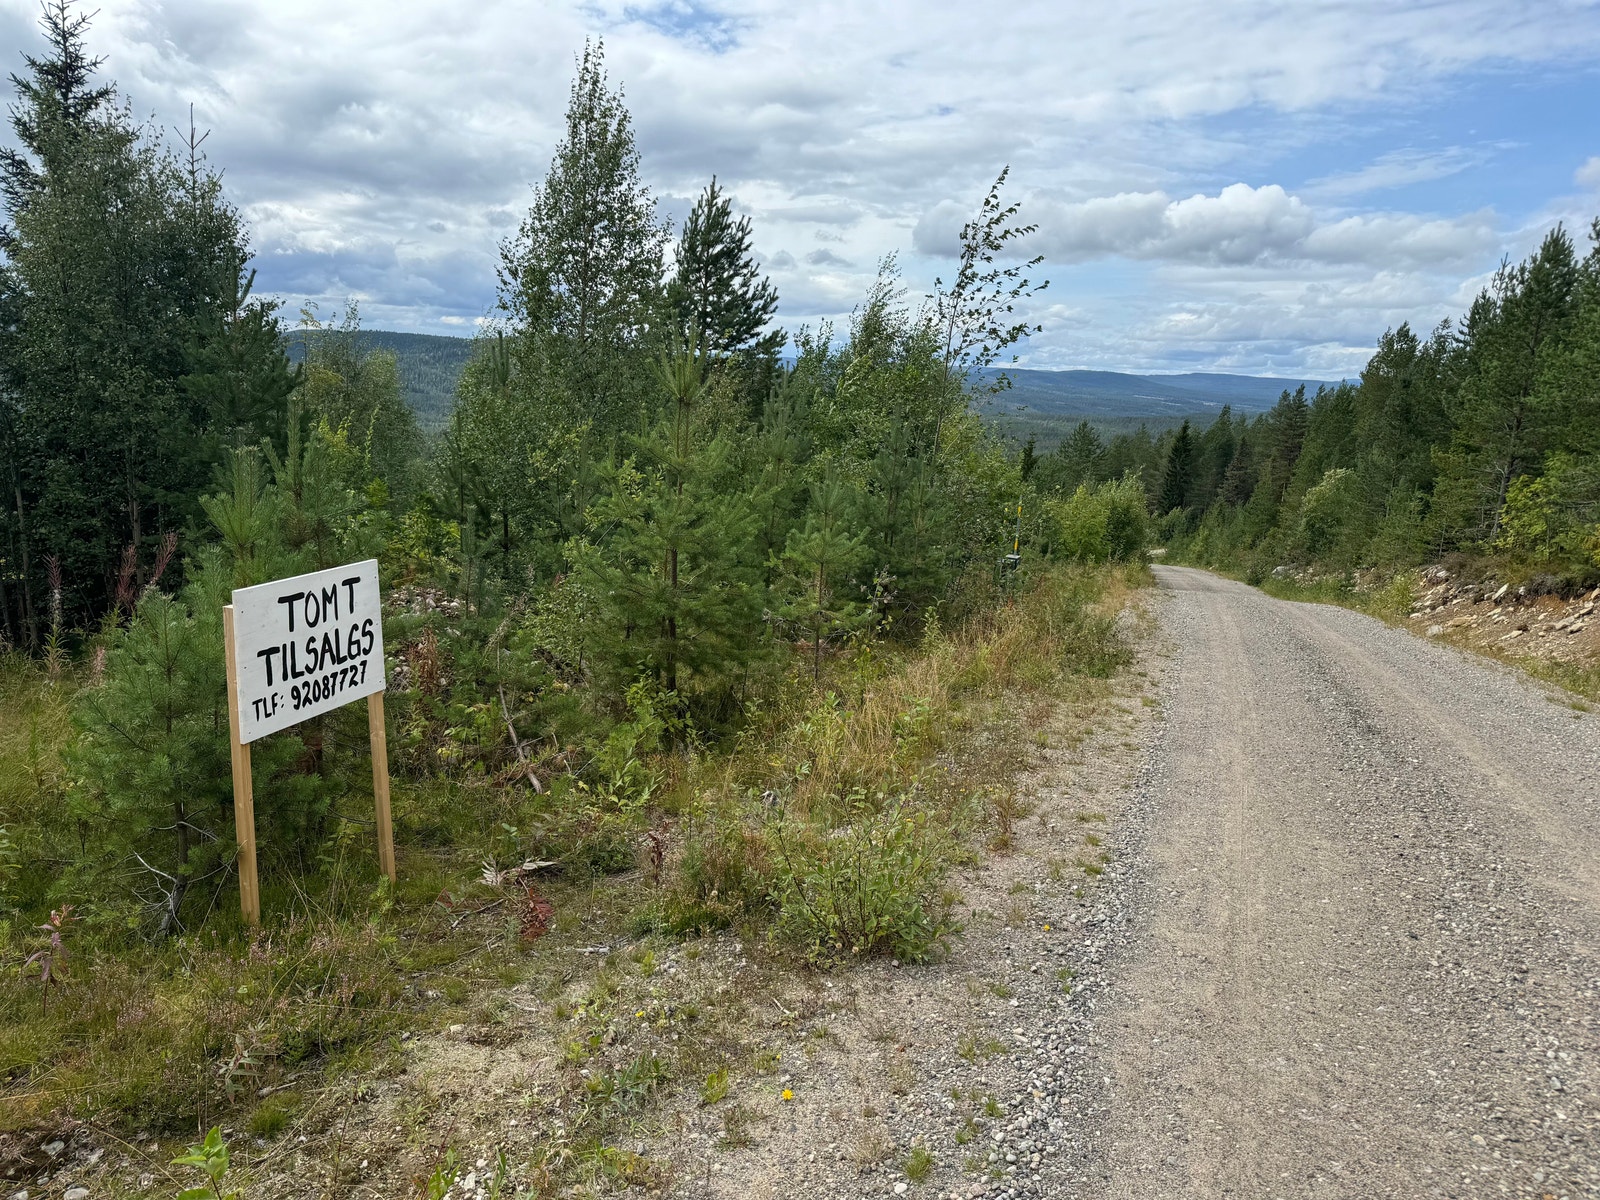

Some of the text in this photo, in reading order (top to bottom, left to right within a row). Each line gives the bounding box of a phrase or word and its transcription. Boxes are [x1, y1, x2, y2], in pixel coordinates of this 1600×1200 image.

[277, 576, 361, 632] TOMT
[257, 618, 375, 687] TILSALGS
[252, 660, 368, 722] TLF: 92087727
